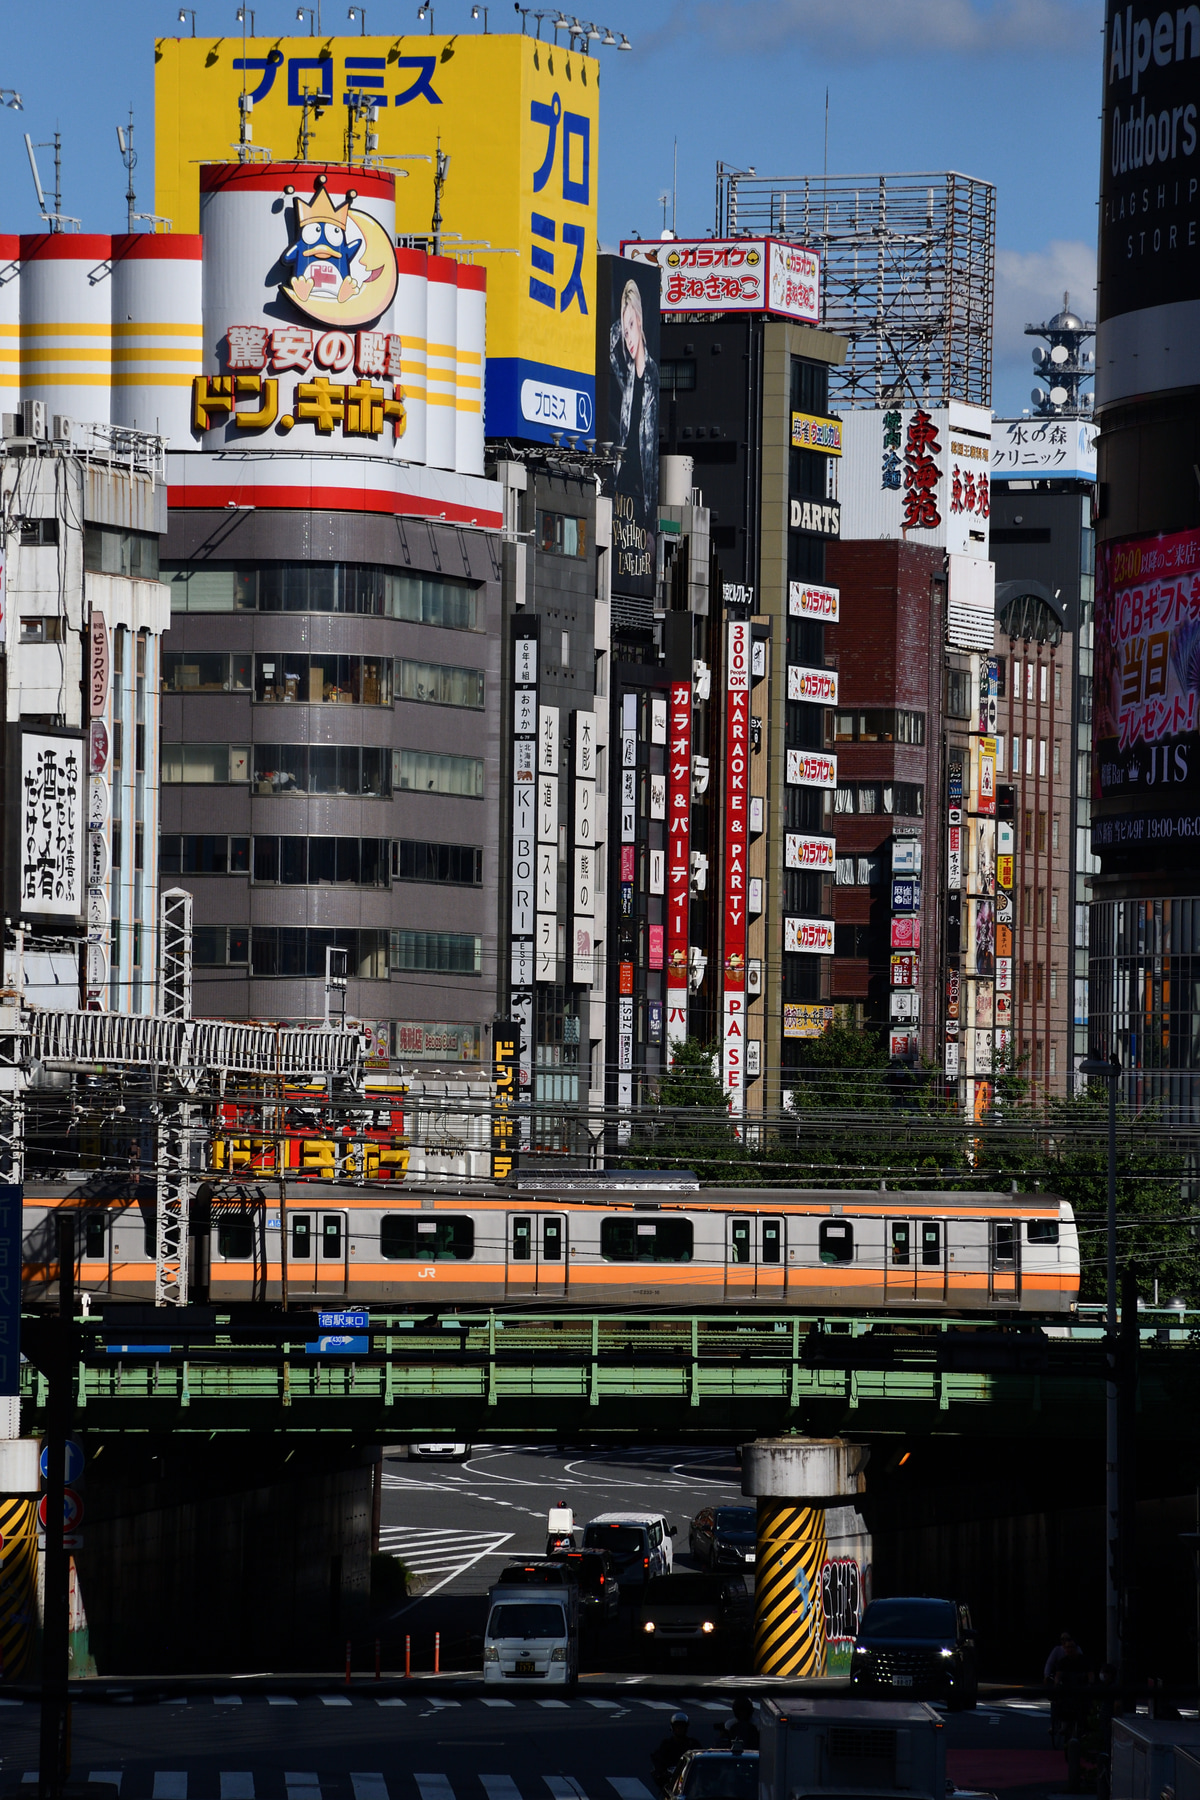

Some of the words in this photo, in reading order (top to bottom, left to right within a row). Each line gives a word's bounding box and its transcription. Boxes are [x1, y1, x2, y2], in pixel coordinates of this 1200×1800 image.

[1109, 4, 1200, 95] Alpen
[232, 50, 443, 107] プロミス
[530, 92, 592, 207] プロ
[1112, 96, 1197, 177] Outdoors
[1105, 178, 1198, 226] FLAGSHIP
[1127, 221, 1196, 259] STORE
[529, 211, 590, 316] ミス
[680, 249, 747, 267] カラオケ
[789, 255, 812, 275] カラオケ
[666, 272, 760, 304] まねきねこ
[785, 279, 815, 309] まねきねこ
[227, 326, 402, 377] 驚安の殿堂
[535, 391, 567, 421] プロミス
[1009, 425, 1068, 446] 水の森
[901, 409, 942, 527] 東海苑
[991, 449, 1068, 468] クリニック
[614, 491, 634, 521] MIO
[790, 500, 839, 535] DARTS
[612, 520, 647, 550] YASHIRO
[806, 590, 832, 613] カラオケ
[521, 643, 530, 680] 6年4組
[730, 676, 746, 686] OK
[805, 675, 831, 697] カラオケ
[521, 694, 530, 730] おかか
[731, 692, 745, 810] KARAOKE
[1146, 744, 1189, 786] JIS
[804, 758, 829, 780] カラオケ
[731, 820, 743, 833] &
[517, 790, 530, 929] KIBORI
[803, 843, 828, 864] カラオケ
[730, 844, 743, 926] PARTY
[801, 926, 827, 947] カラオケ
[418, 1267, 436, 1278] JR
[318, 1314, 364, 1326] 宿駅東口
